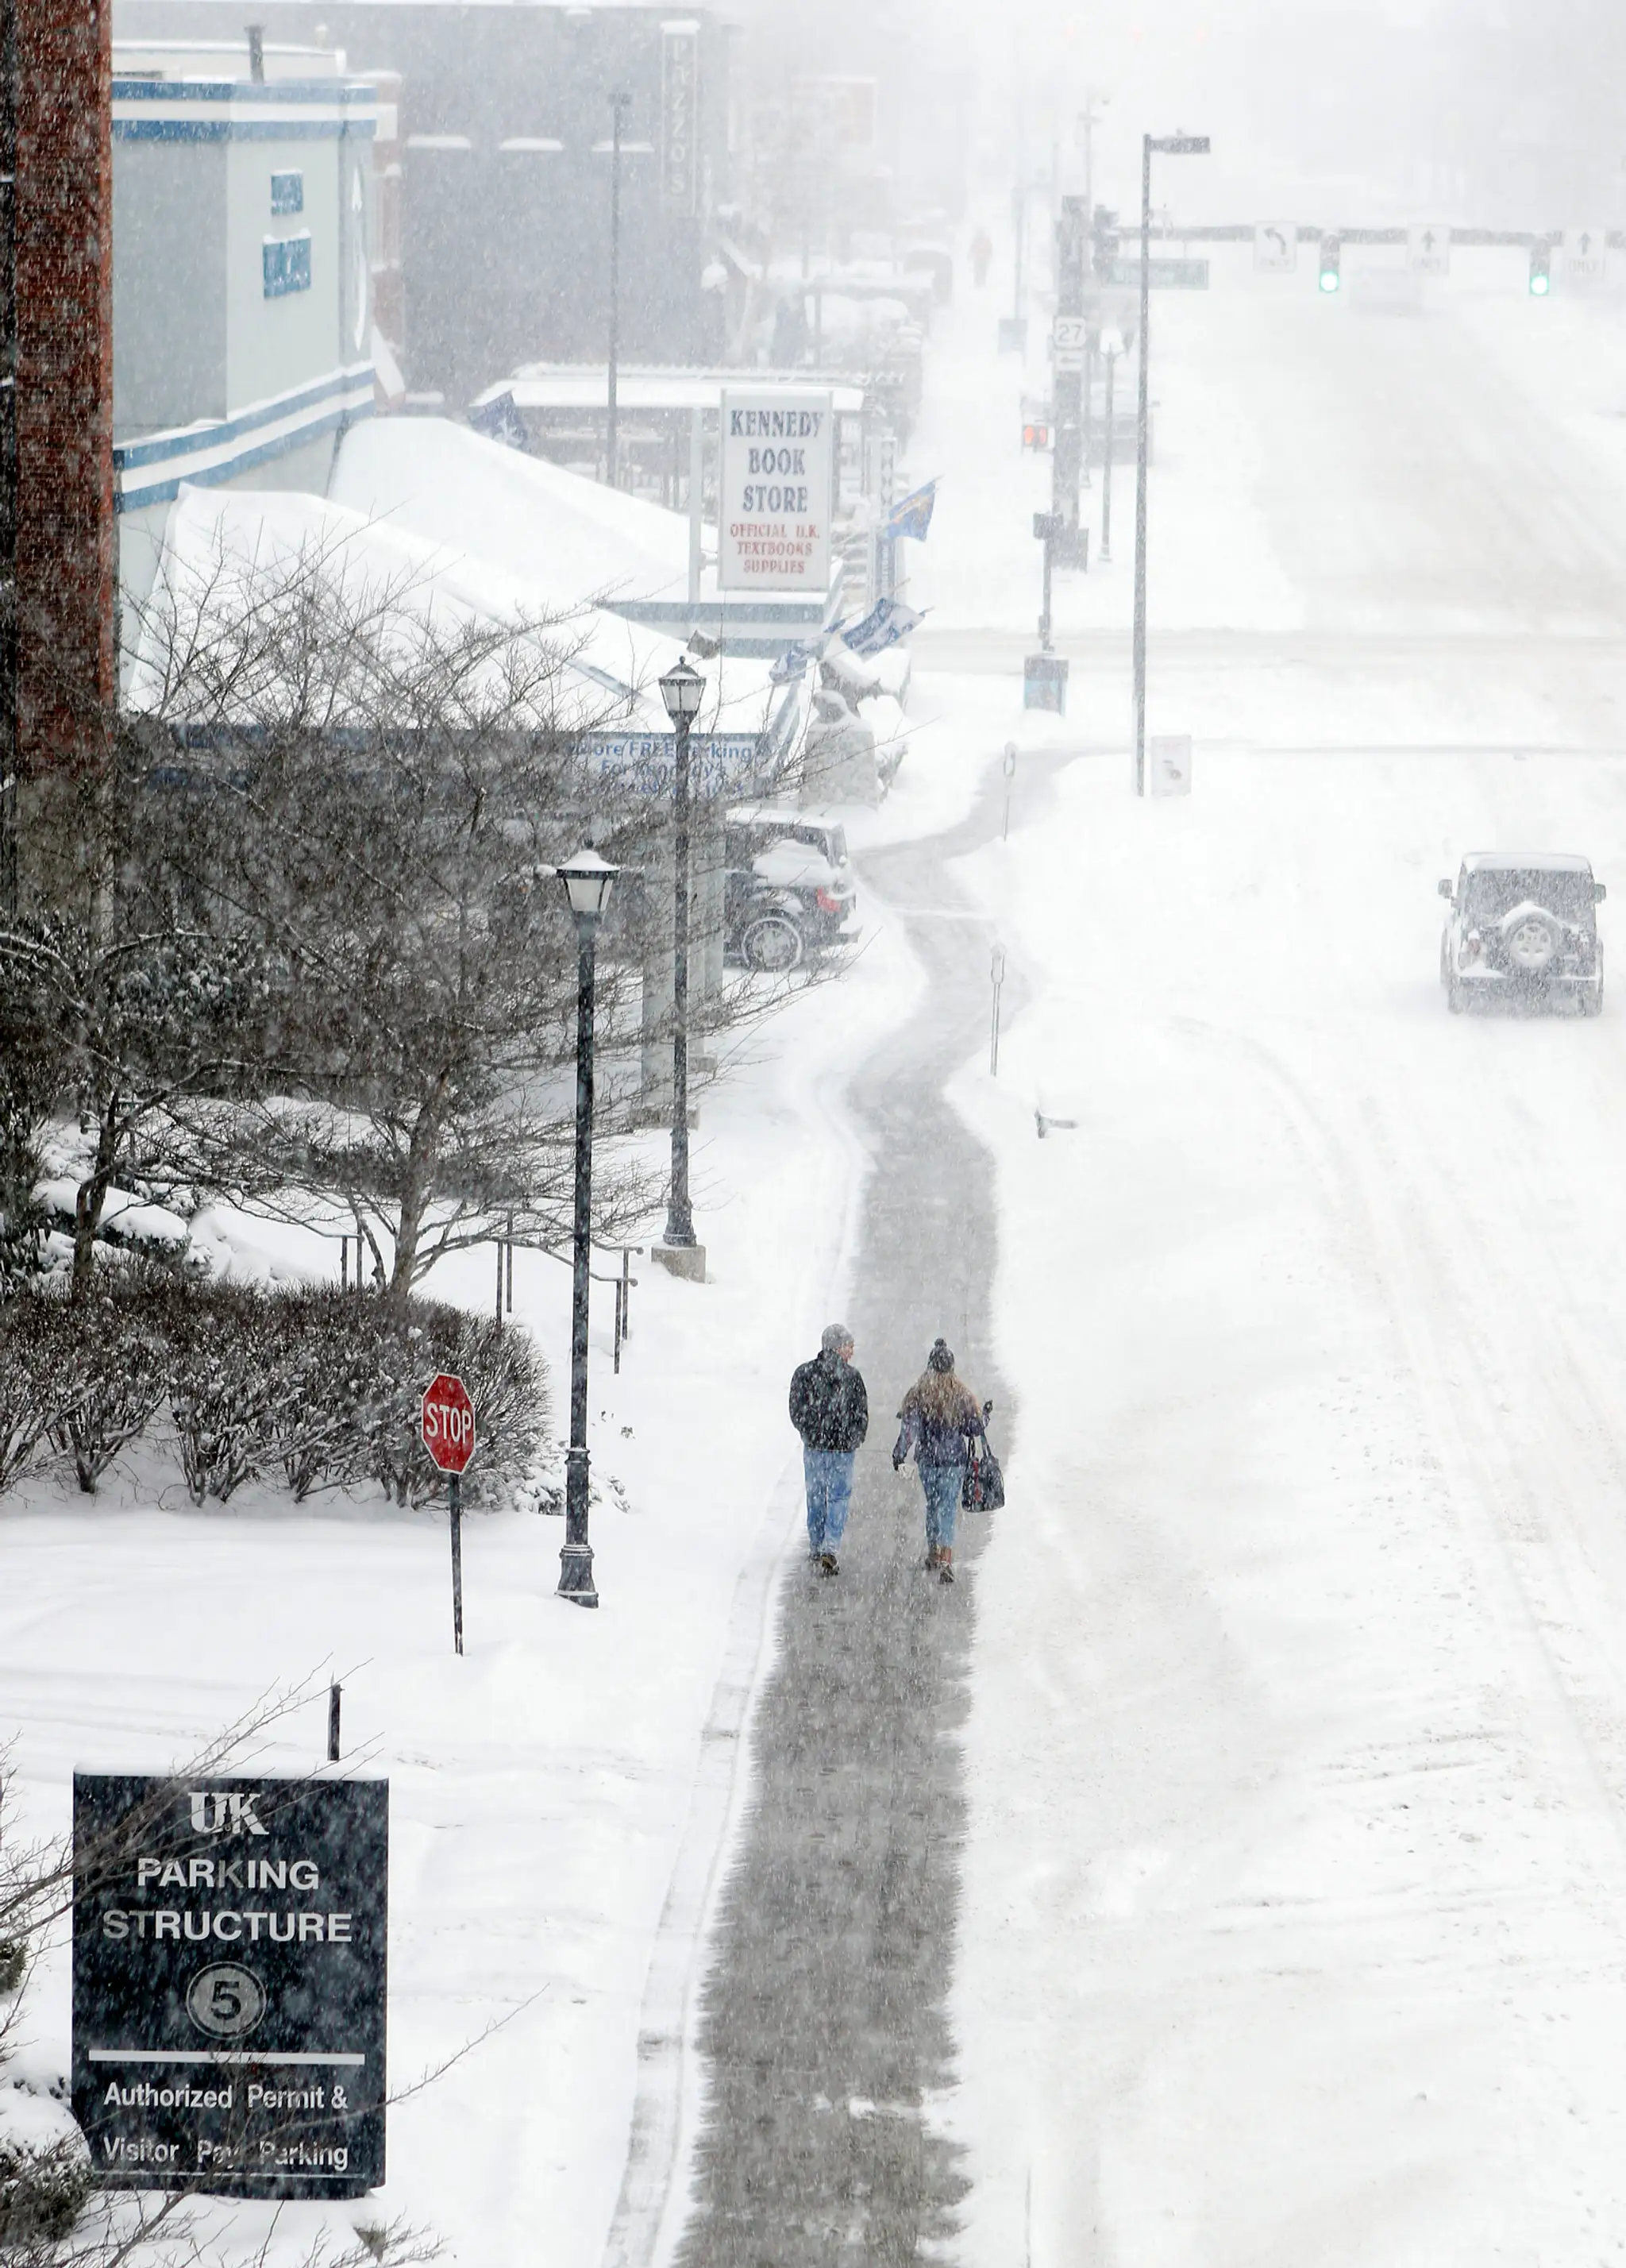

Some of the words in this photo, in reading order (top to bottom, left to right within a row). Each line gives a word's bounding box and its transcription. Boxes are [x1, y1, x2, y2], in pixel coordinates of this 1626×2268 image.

[1568, 258, 1600, 273] ONLY
[1058, 323, 1082, 343] 27
[730, 410, 823, 438] KENNEDY
[749, 448, 805, 476] BOOK
[742, 484, 808, 512] STORE
[730, 523, 788, 538] OFFICIAL
[796, 523, 820, 538] U.K.
[737, 541, 813, 556] TEXTBOOKS
[743, 558, 806, 574] SUPPLIES
[426, 1402, 472, 1444] STOP
[187, 1792, 270, 1835] UK
[137, 1857, 319, 1890] PARKING
[102, 1910, 353, 1942] STRUCTURE
[210, 1981, 242, 2020] 5
[103, 2081, 233, 2109] Authorized
[247, 2084, 325, 2109] Permit
[330, 2085, 349, 2109] &
[103, 2136, 180, 2162] Visitor
[258, 2140, 349, 2172] Parking
